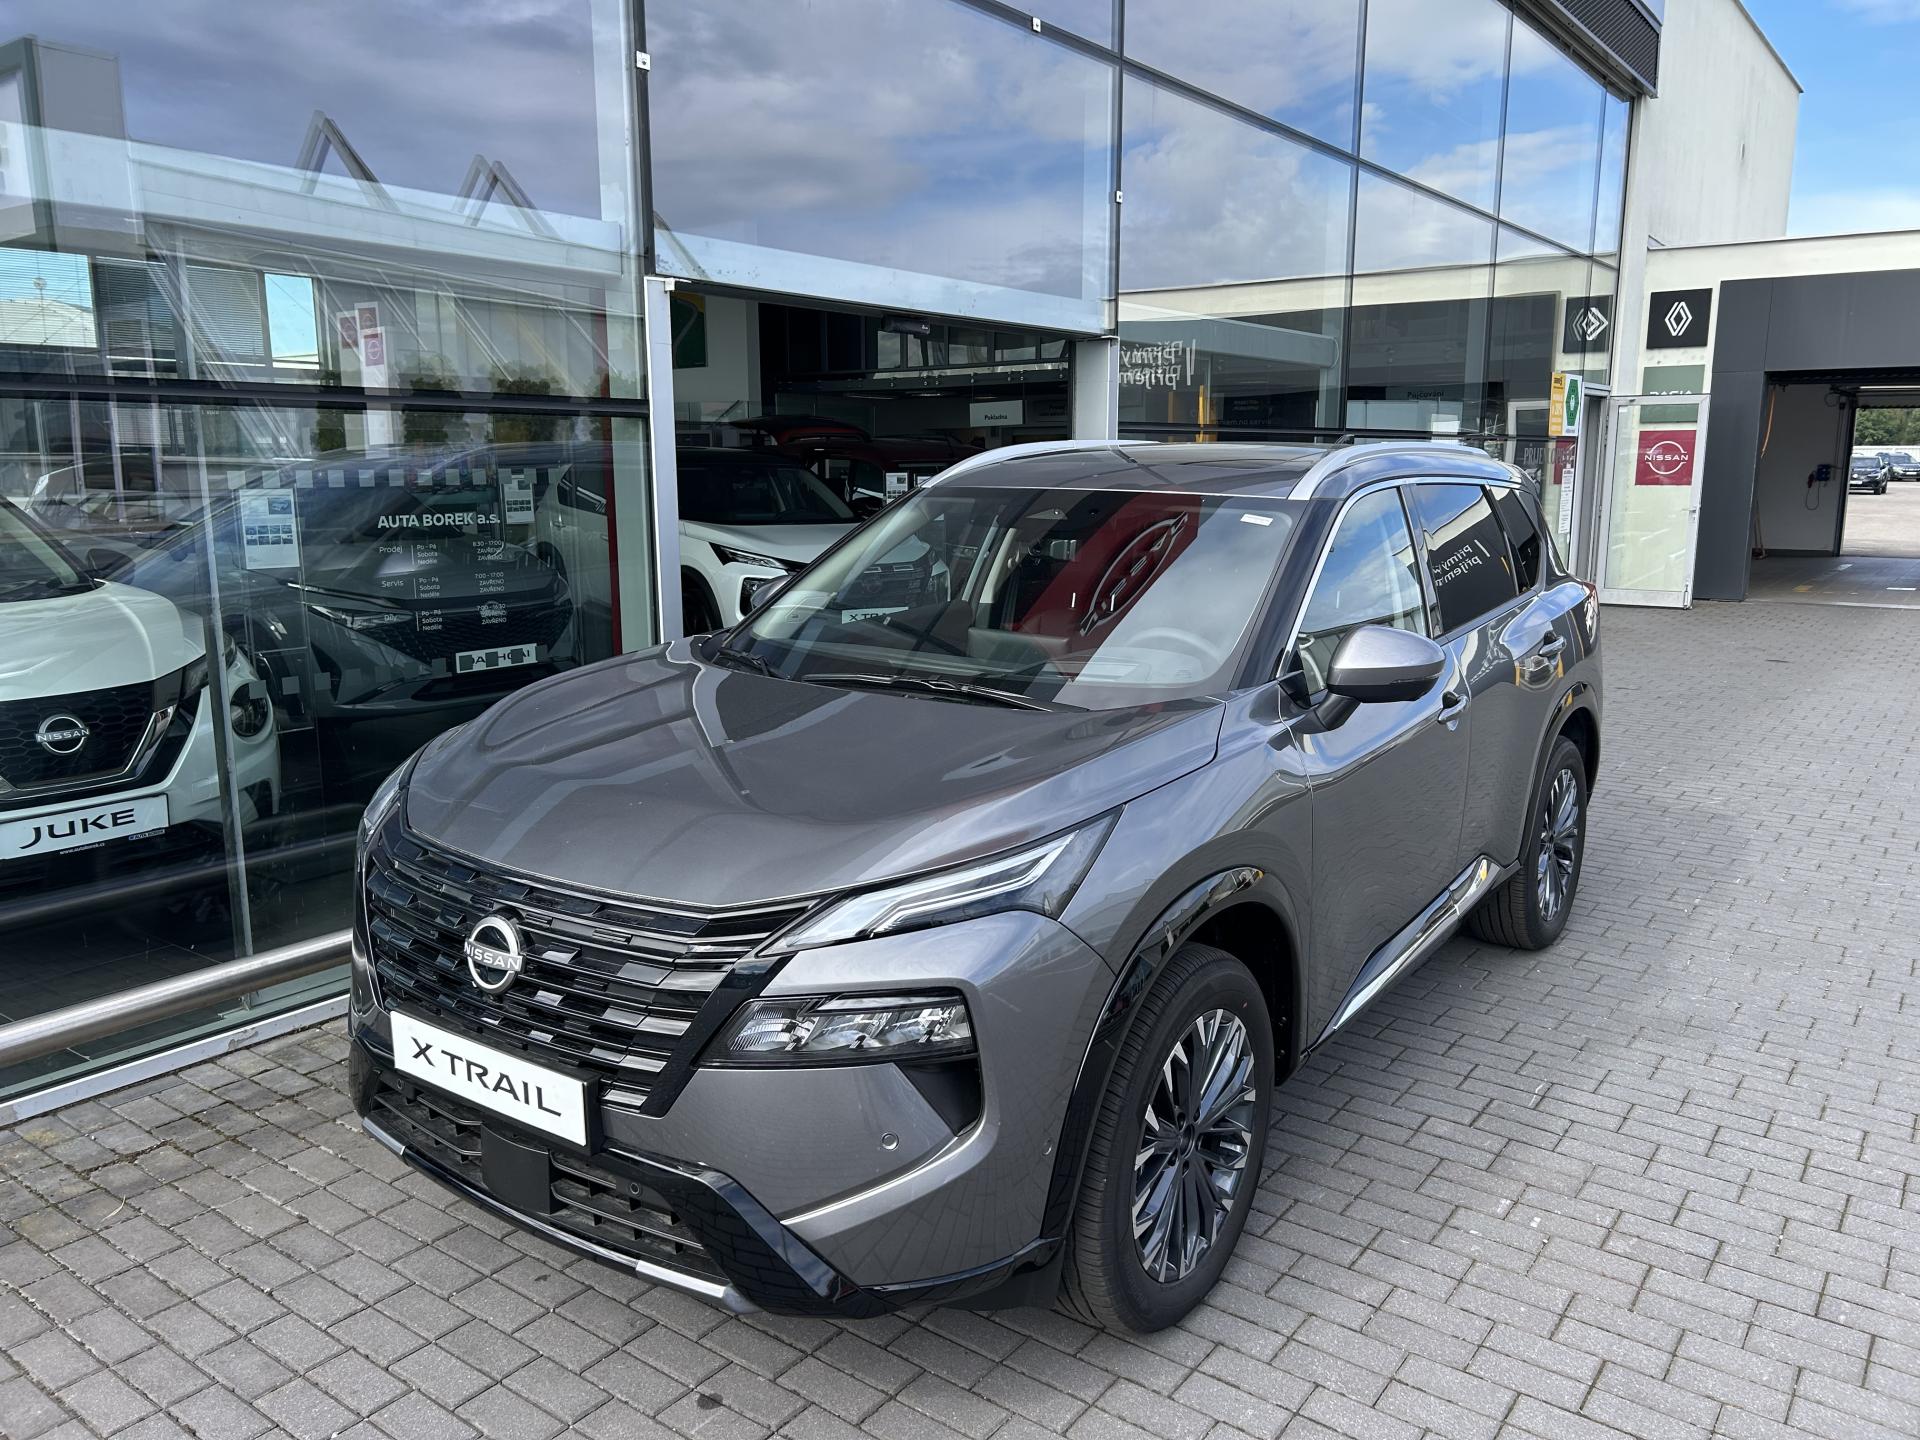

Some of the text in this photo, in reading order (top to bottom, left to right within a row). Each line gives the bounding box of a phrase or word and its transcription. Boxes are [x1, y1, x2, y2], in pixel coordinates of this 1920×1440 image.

[377, 512, 501, 529] AUTA BOREK a.s.
[379, 545, 403, 554] Prodej
[381, 580, 404, 588] Servis
[479, 578, 505, 586] ZAVŘENO
[479, 585, 505, 593] ZAVŘENO
[37, 728, 90, 742] NISSAN
[18, 808, 136, 850] JUKE
[463, 940, 523, 971] NISSAN
[410, 1036, 562, 1118] X TRAIL
